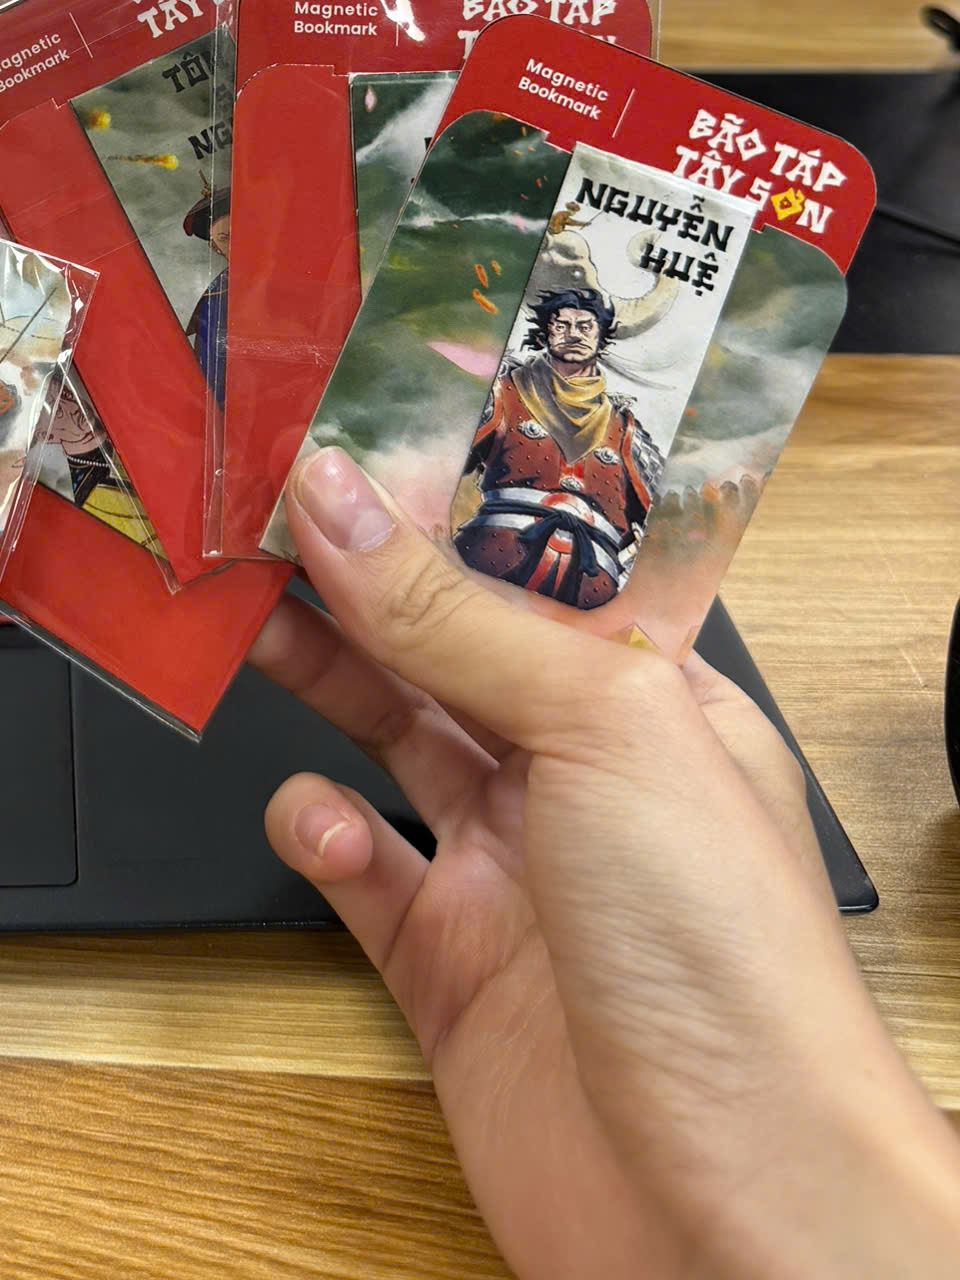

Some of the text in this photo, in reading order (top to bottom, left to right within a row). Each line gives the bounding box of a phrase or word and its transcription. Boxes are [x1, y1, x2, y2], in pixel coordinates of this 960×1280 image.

[293, 0, 378, 22] Magnetic
[293, 19, 378, 36] Bookmark
[517, 75, 602, 121] Bookmark
[525, 57, 610, 103] Magnetic
[688, 108, 848, 193] BÃO TÁP
[673, 145, 834, 234] TÂY SƠN
[575, 177, 735, 253] NGUYỄN
[639, 242, 721, 297] HUỆ
